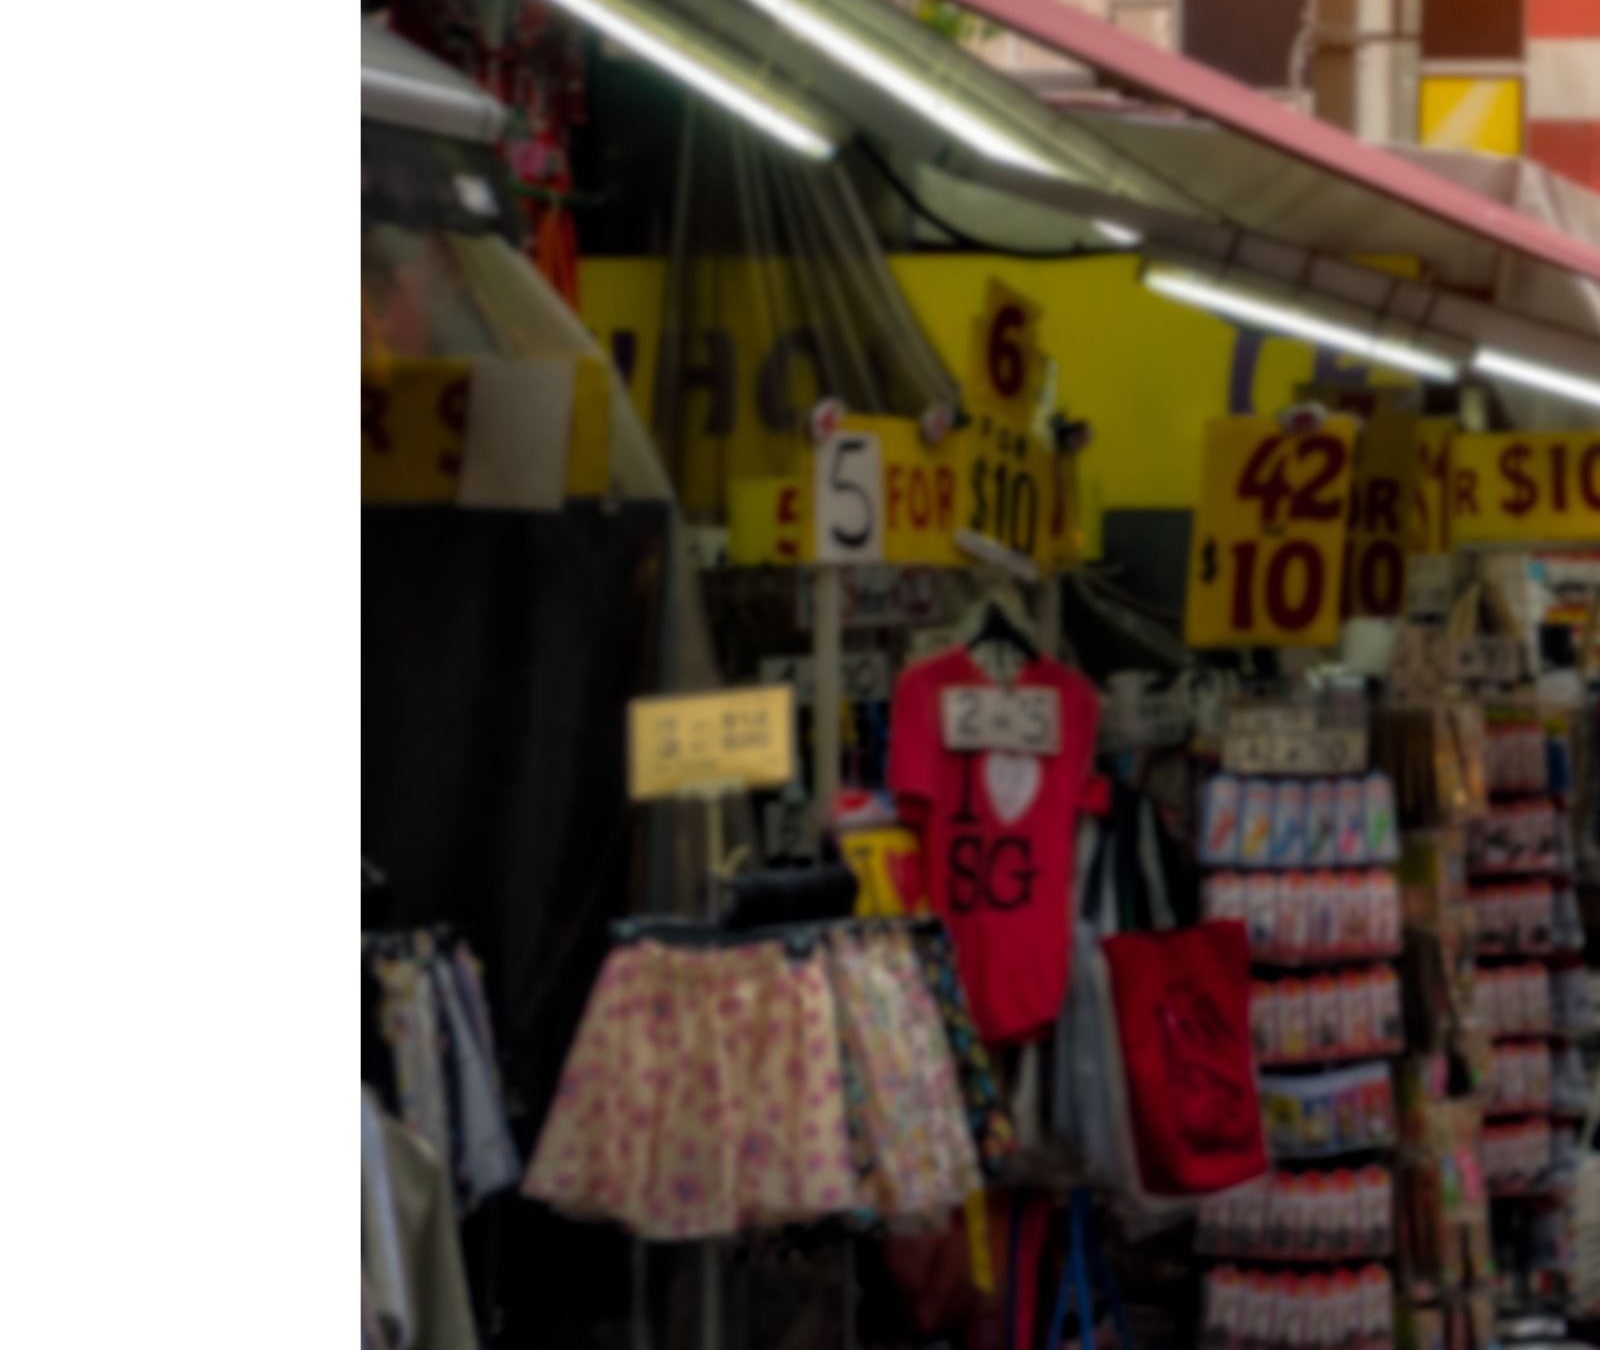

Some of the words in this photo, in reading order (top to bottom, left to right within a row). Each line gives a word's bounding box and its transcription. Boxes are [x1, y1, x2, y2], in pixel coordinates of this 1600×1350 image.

[990, 306, 1024, 395] 6
[831, 440, 874, 547] 5
[888, 465, 956, 530] FOR
[1238, 437, 1345, 523] 42
[948, 834, 1041, 914] SG
